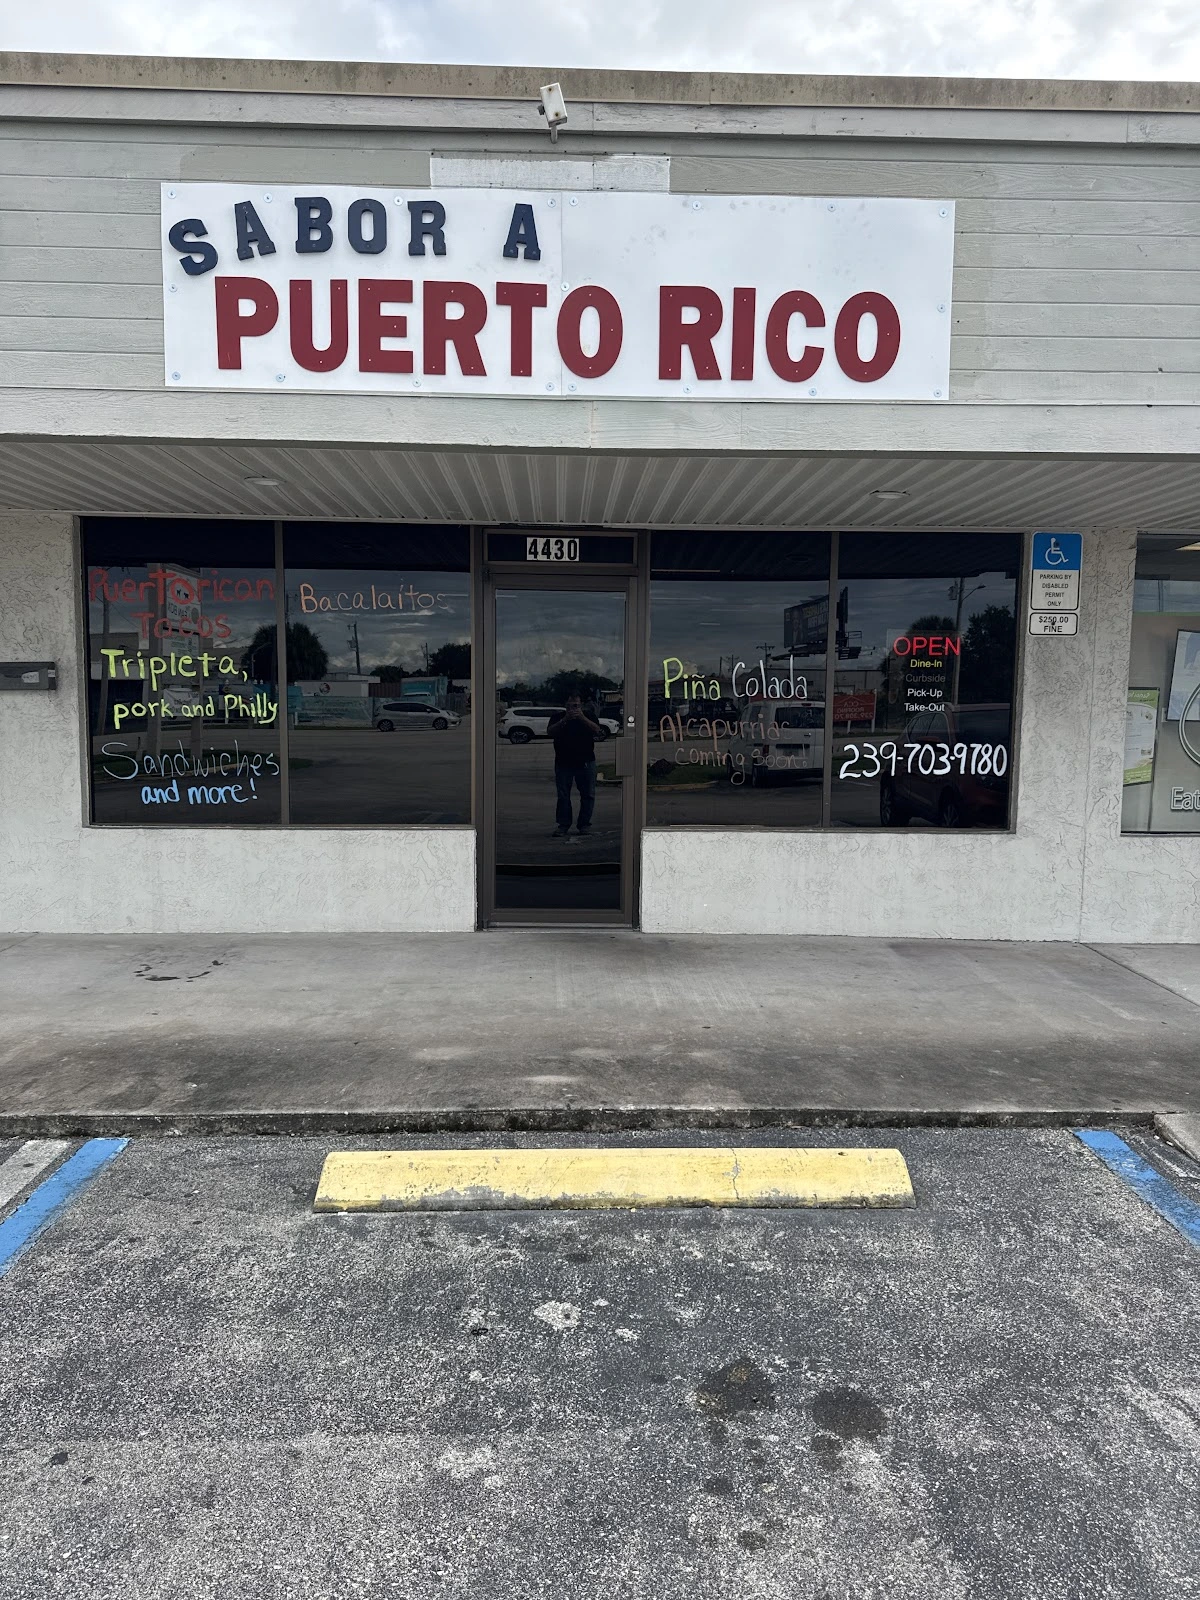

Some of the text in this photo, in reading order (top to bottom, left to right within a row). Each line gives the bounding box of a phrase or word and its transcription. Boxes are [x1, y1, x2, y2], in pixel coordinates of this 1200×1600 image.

[168, 195, 541, 276] SABOR A
[214, 276, 902, 383] PUERTO RICO
[528, 538, 578, 560] 4430
[1043, 625, 1063, 633] FINE
[893, 636, 961, 656] OPEN
[100, 649, 247, 691] Tripleta,
[663, 654, 808, 700] Piña Colada
[910, 659, 943, 668] Dine-In
[905, 674, 946, 683] Curbside
[907, 688, 943, 698] Pick-Up
[113, 699, 173, 729] pork
[181, 696, 215, 717] and
[224, 692, 278, 724] Philly
[904, 703, 946, 712] Take-Out
[101, 739, 280, 780] Sandwiches
[839, 741, 1008, 779] 239-703-9780
[141, 778, 258, 805] and more!
